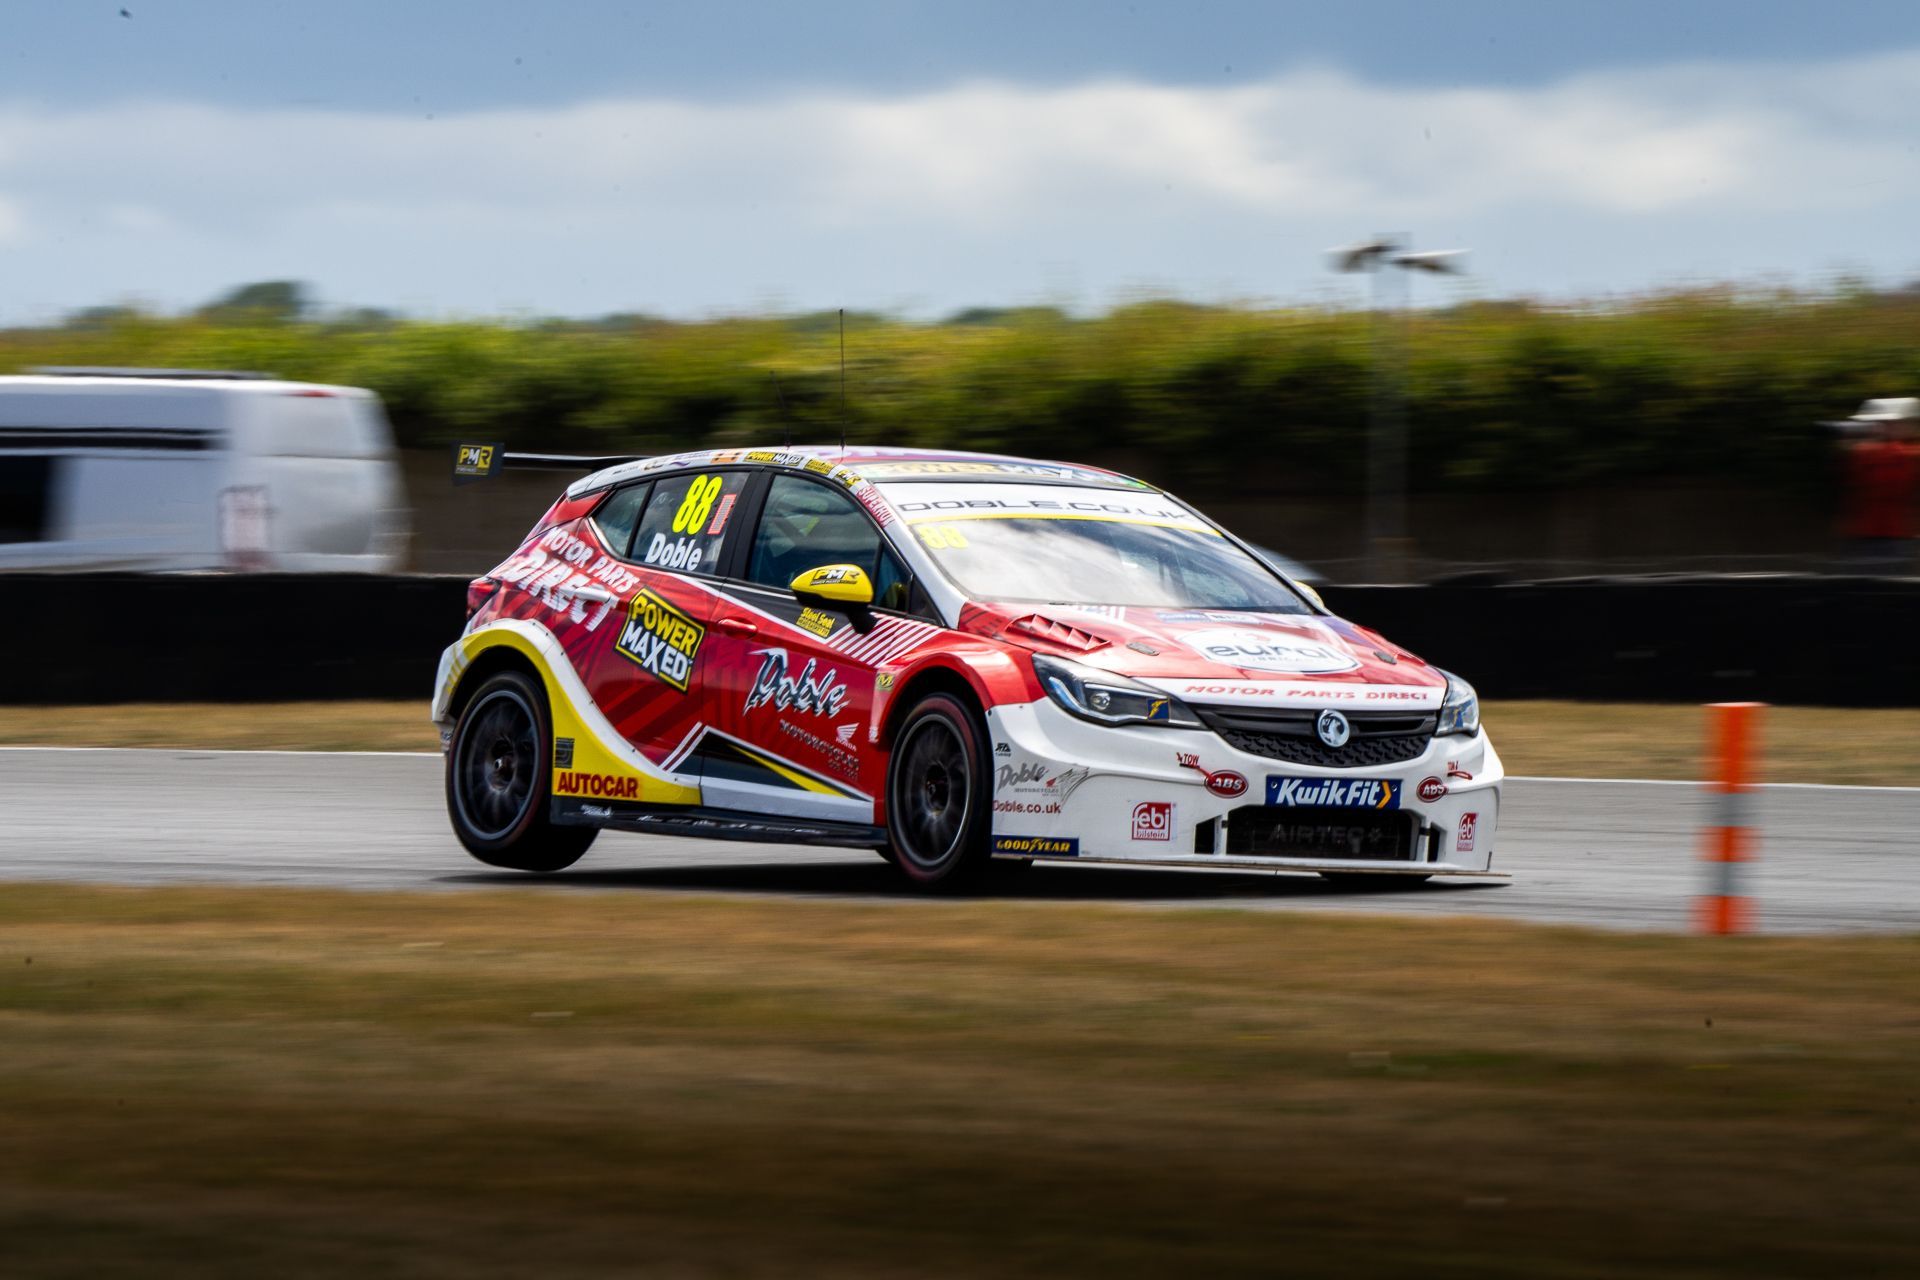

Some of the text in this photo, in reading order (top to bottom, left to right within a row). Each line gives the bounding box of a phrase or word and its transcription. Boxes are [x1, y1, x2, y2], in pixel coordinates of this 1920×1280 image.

[460, 447, 492, 466] PMR
[672, 474, 723, 535] 88
[917, 526, 969, 548] 88
[540, 526, 640, 593] MOTOR PARTS
[645, 533, 702, 571] Doble
[499, 549, 620, 632] DIRECT
[632, 595, 697, 656] POWER
[621, 621, 689, 681] MAXED
[743, 648, 851, 719] Doble
[1184, 685, 1275, 696] MOTOR
[1287, 689, 1355, 699] PARTS
[1182, 753, 1200, 766] TOW
[557, 772, 638, 798] AUTOCAR
[996, 763, 1050, 794] Doble
[1212, 778, 1243, 790] ABS
[1422, 783, 1446, 796] ABS
[992, 800, 1062, 814] Doble.co.uk
[1133, 804, 1170, 831] febi
